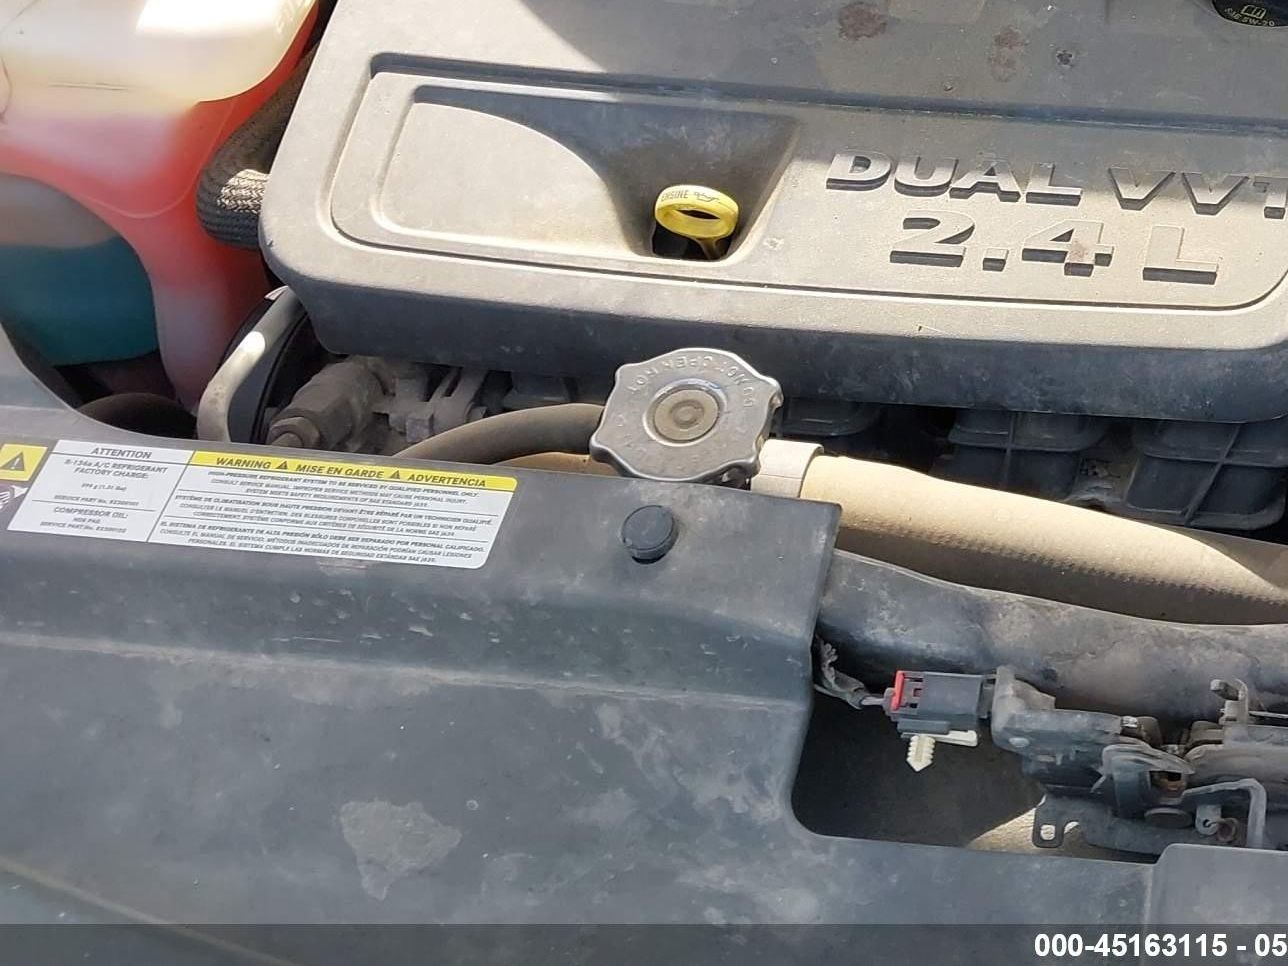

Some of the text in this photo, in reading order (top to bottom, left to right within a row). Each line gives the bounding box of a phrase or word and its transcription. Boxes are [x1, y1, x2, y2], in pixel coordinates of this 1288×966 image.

[826, 152, 1082, 206] DUAL
[660, 189, 689, 202] ENGINE
[889, 209, 1220, 285] 2.4 L
[90, 447, 153, 459] ATTENTION
[72, 466, 113, 475] FACTORY
[216, 457, 486, 487] WARNING MISE EN GARDE ADVERTENCIA
[52, 506, 111, 517] COMPRESSOR
